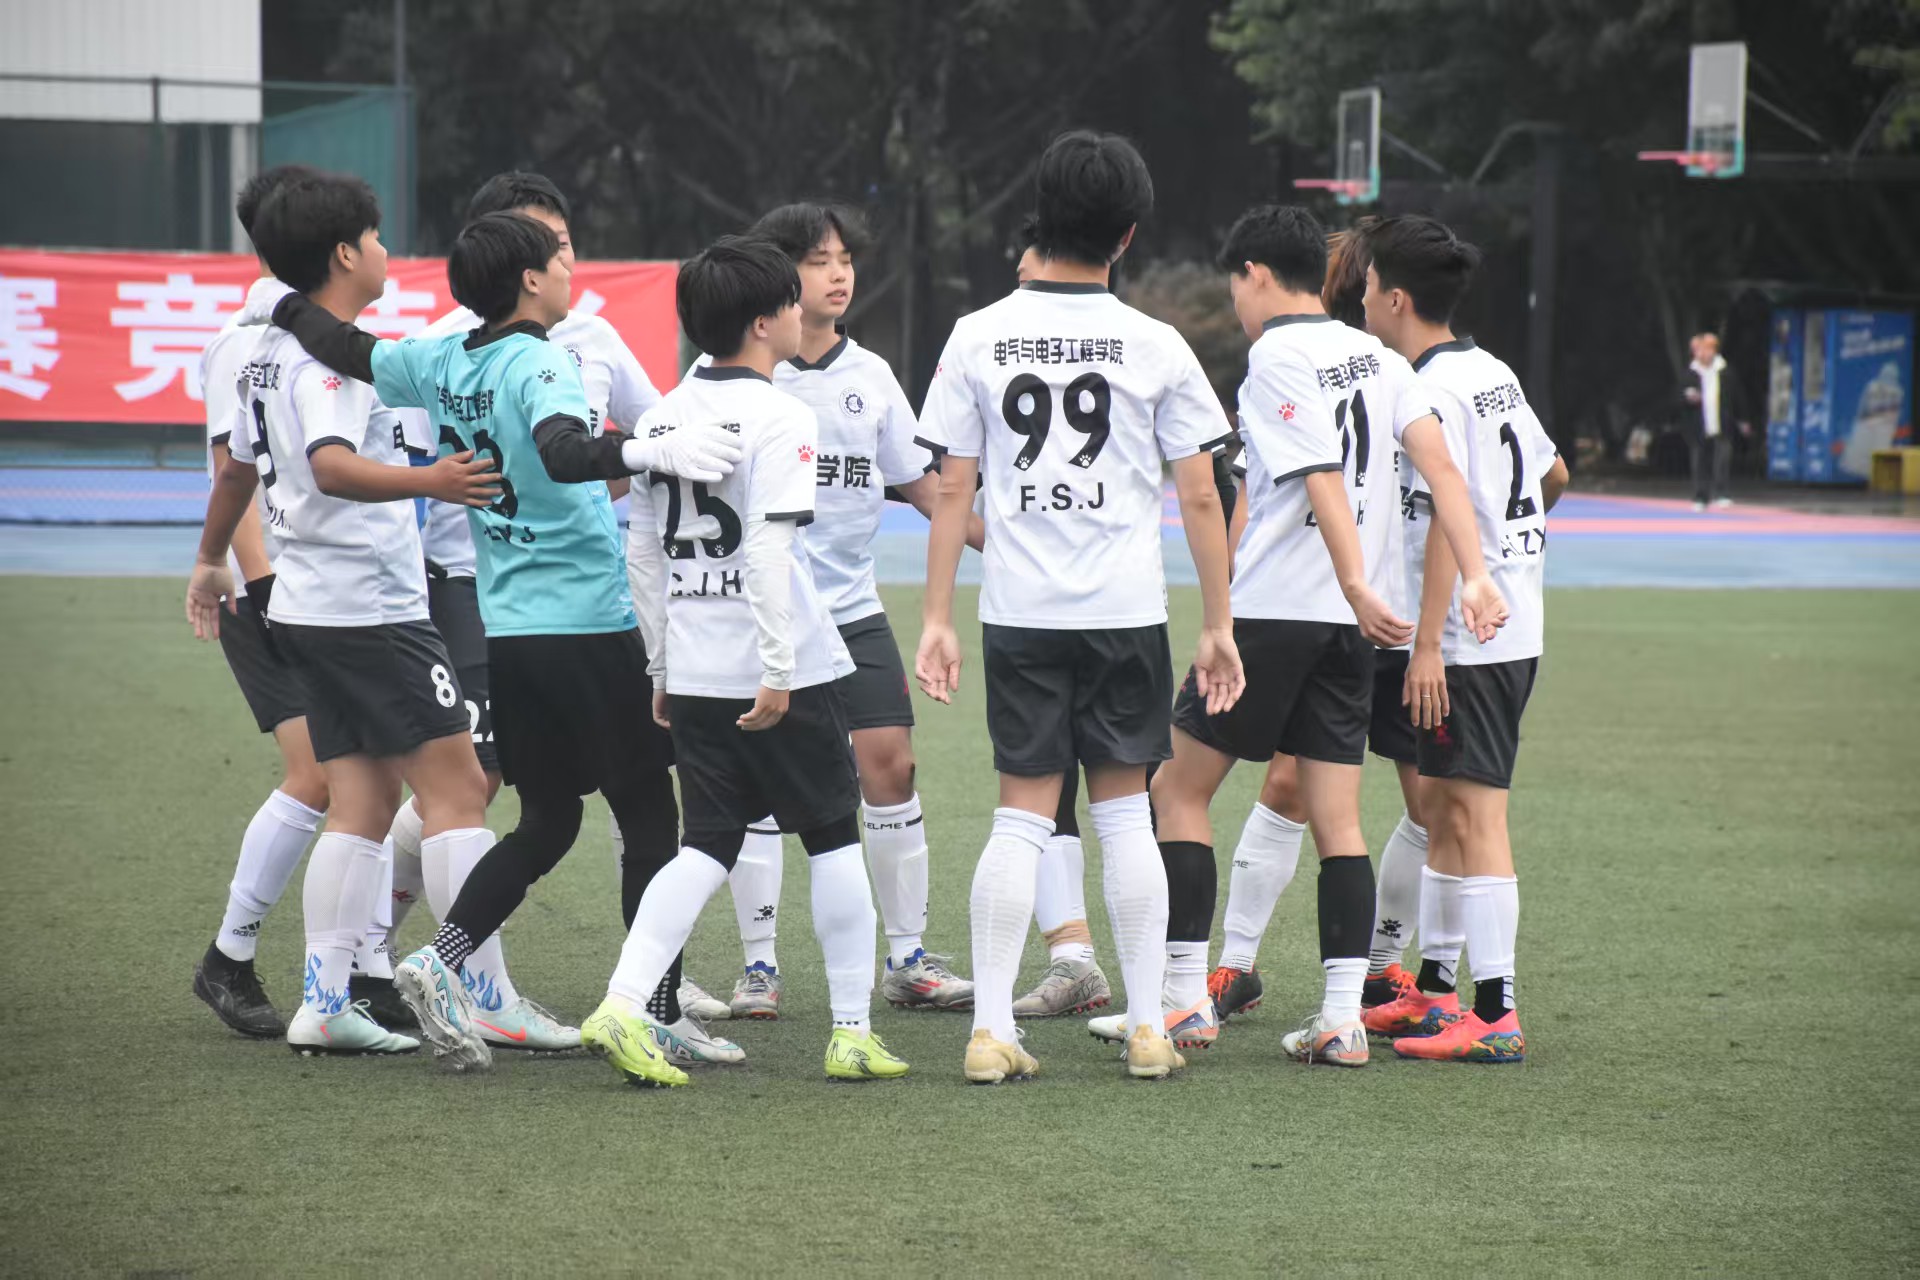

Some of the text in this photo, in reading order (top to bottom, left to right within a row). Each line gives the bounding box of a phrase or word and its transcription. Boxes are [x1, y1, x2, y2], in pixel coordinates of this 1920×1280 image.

[993, 336, 1124, 366] 电气与电子工程学院
[1002, 371, 1111, 471] 99
[816, 453, 871, 488] 学院
[649, 471, 742, 559] 25
[1020, 481, 1104, 511] F.S.J
[430, 664, 457, 708] 8
